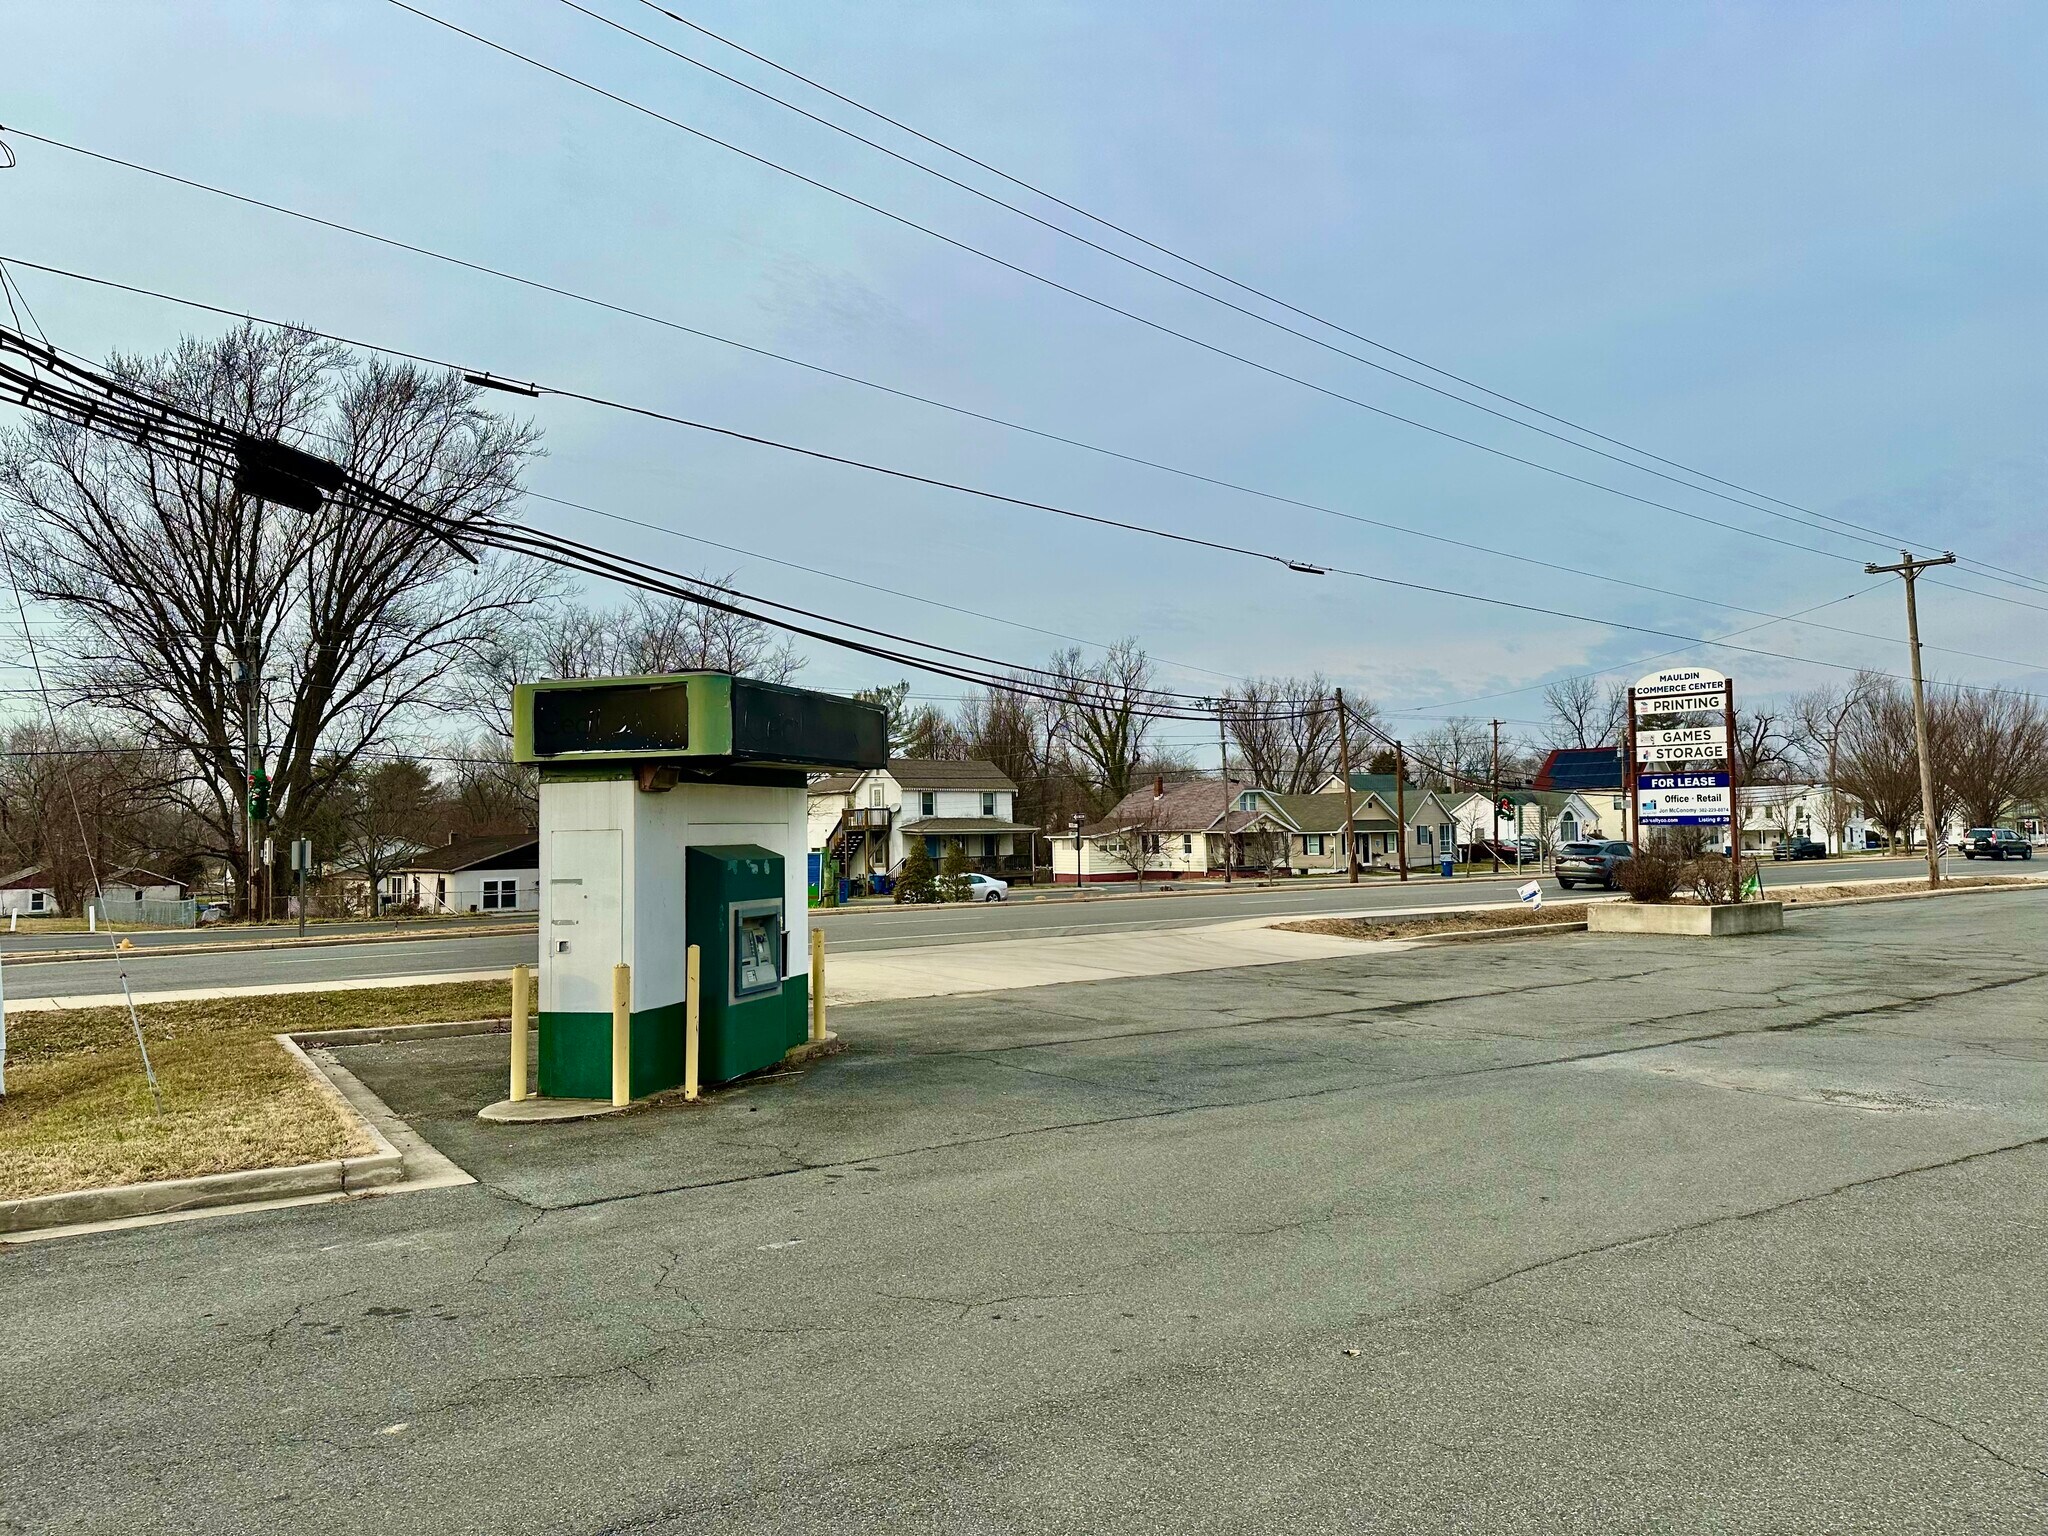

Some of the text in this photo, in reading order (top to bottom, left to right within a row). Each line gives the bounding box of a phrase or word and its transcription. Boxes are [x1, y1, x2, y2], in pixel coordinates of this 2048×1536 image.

[1659, 672, 1700, 682] MAULDIN
[1637, 681, 1723, 694] COMMERCE CENTER
[1654, 697, 1719, 711] PRINTING
[1663, 730, 1711, 743] GAMES
[1656, 746, 1722, 759] STORAGE
[1652, 777, 1716, 787] FOR LEASE
[1664, 793, 1722, 803] Office Retail
